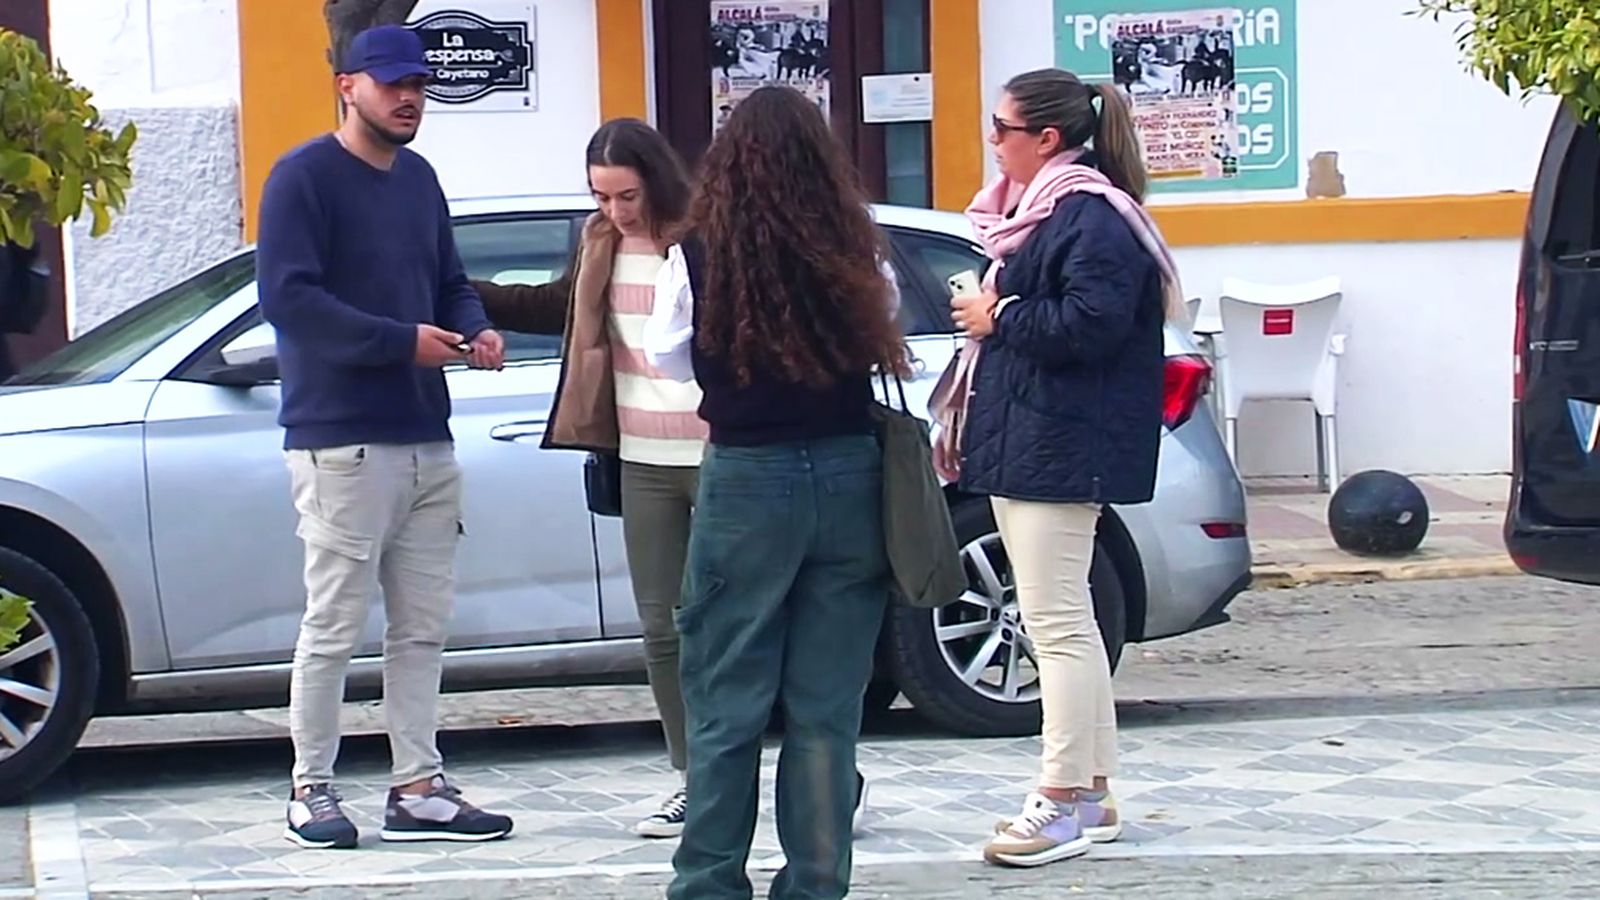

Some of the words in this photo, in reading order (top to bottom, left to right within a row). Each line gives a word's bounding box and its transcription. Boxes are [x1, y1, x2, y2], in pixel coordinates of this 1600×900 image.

[718, 6, 762, 20] ALCALÁ
[1117, 19, 1165, 38] ALCALÁ
[443, 32, 464, 47] La
[424, 49, 496, 65] espensa
[1147, 143, 1167, 153] RUIZ
